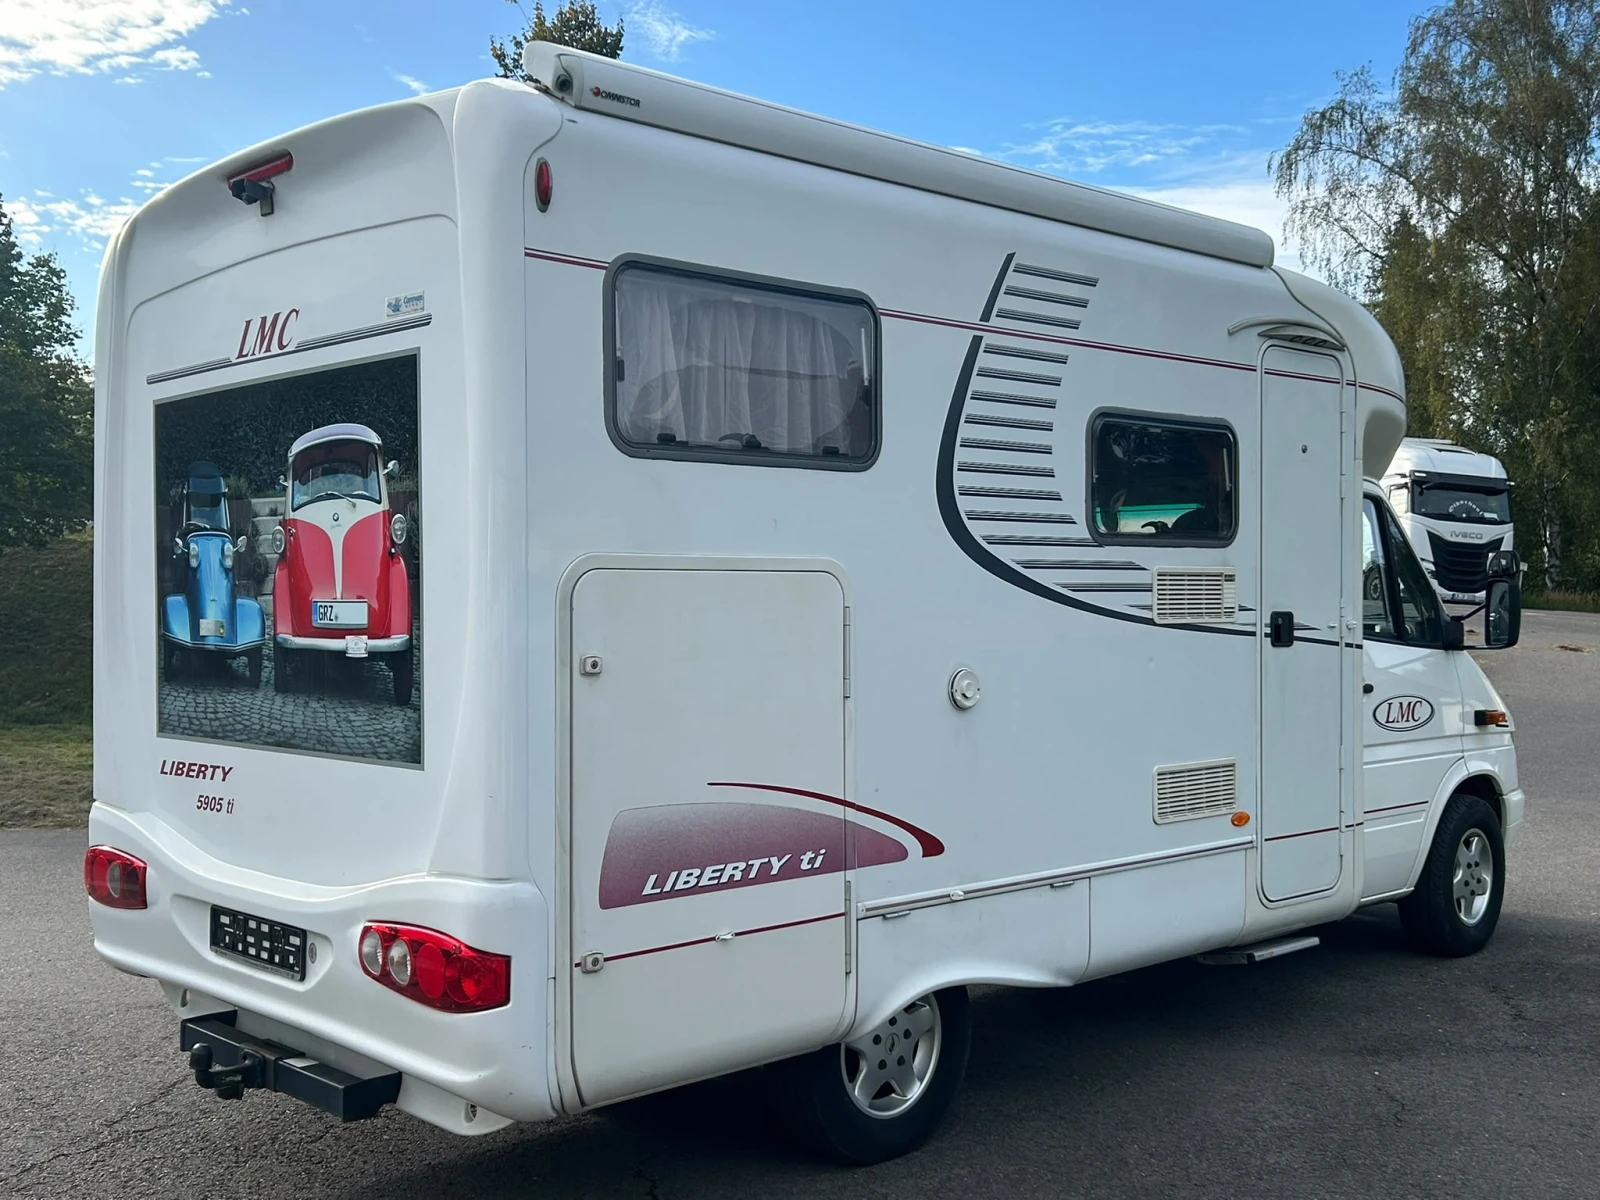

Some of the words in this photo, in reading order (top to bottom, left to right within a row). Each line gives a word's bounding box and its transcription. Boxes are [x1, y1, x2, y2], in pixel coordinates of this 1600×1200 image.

[600, 90, 641, 108] OMNISTOR
[235, 308, 300, 360] LMC
[1450, 531, 1483, 540] IVECO
[318, 604, 334, 622] GRZ
[1384, 700, 1423, 724] LMC
[160, 759, 234, 782] LIBERTY
[196, 794, 224, 813] 5905
[226, 798, 235, 815] ti
[641, 853, 793, 896] LIBERTY
[799, 848, 827, 871] ti
